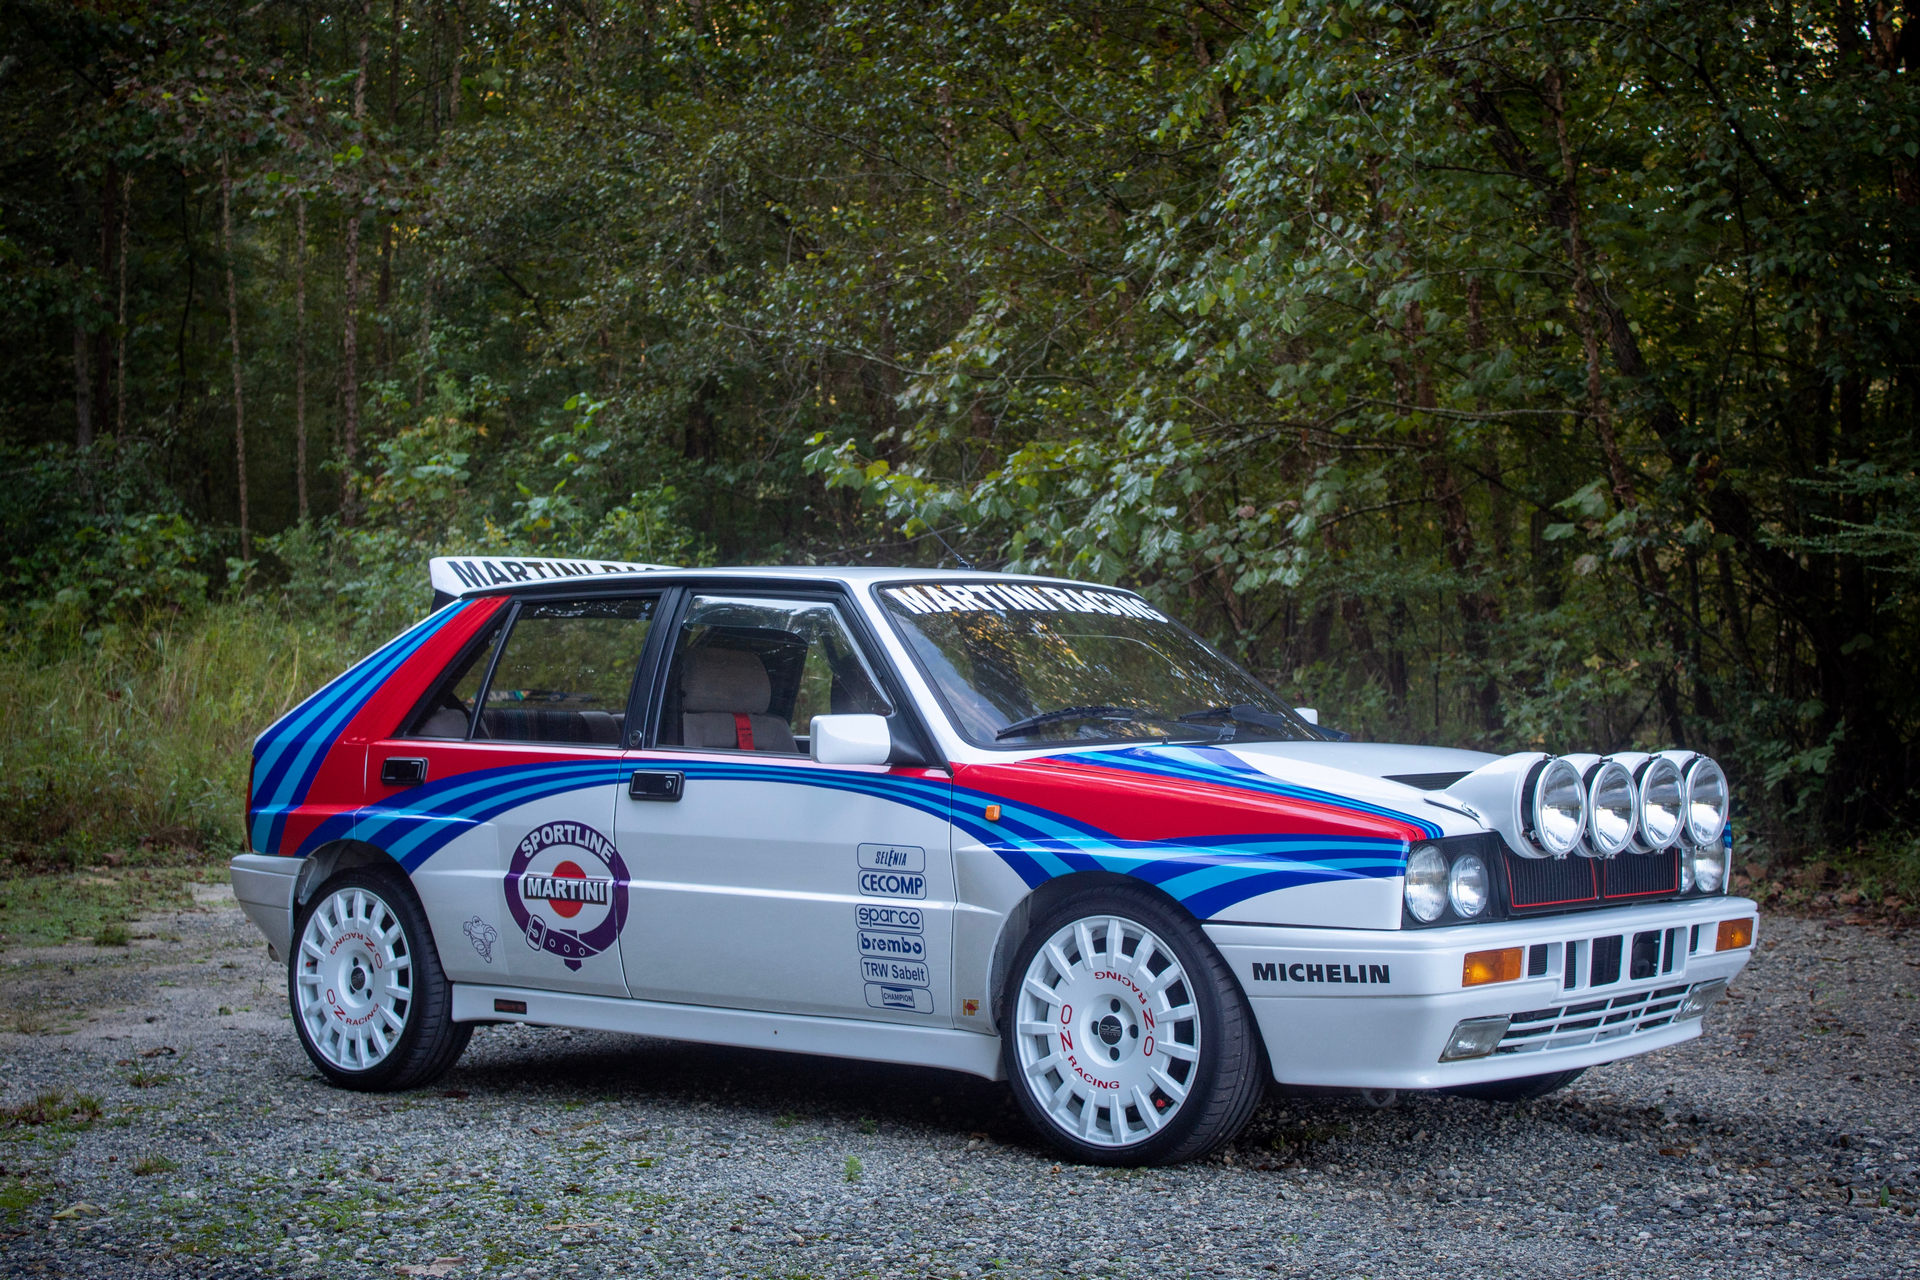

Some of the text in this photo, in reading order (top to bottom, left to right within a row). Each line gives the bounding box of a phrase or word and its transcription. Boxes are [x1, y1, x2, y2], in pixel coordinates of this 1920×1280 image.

[885, 585, 1169, 624] MARTINI RACING
[521, 824, 614, 863] SPORTLINE
[527, 878, 605, 902] MARTINI
[861, 873, 923, 895] CECOMP
[858, 907, 920, 927] sparco
[860, 933, 922, 954] brembo
[863, 961, 926, 982] TRW Sabelt
[1252, 962, 1390, 984] MICHELIN
[883, 992, 913, 1002] CHAMPION
[1094, 971, 1147, 1005] RACING
[1067, 1055, 1120, 1089] RACING
